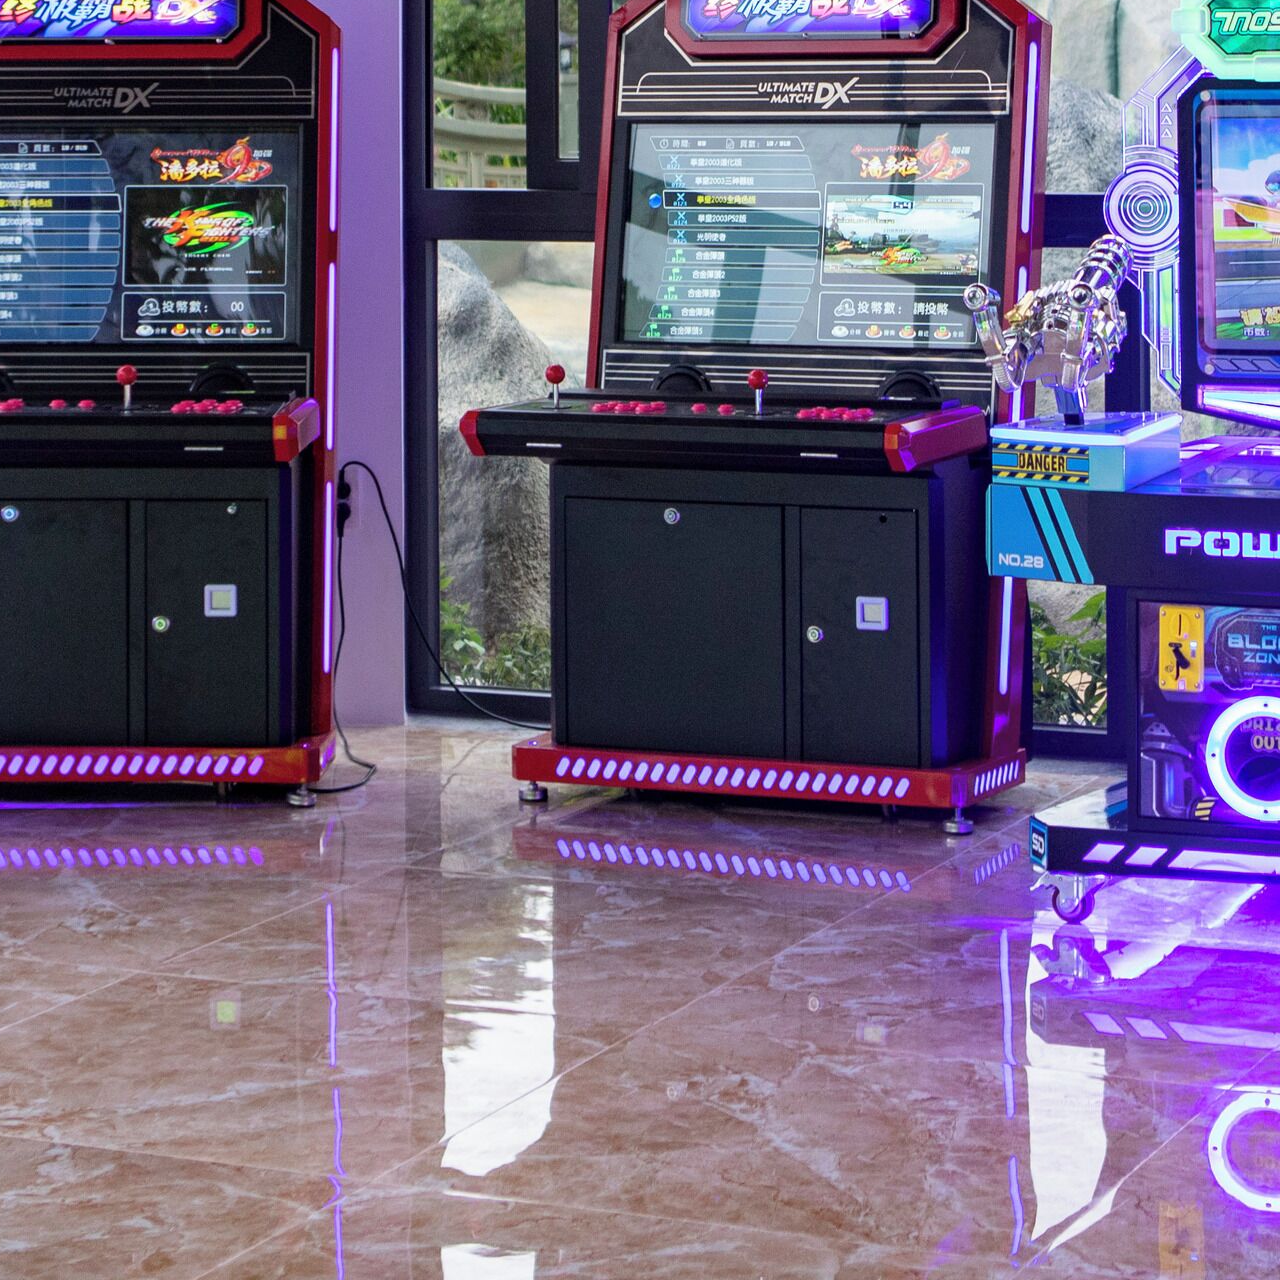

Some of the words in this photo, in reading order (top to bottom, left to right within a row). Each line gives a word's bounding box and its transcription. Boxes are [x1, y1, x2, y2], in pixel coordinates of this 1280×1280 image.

[54, 87, 114, 97] ULTIMATE
[758, 82, 815, 92] ULTIMATE
[814, 76, 860, 109] DX
[67, 98, 112, 108] MATCH
[113, 82, 160, 114] DX
[770, 93, 813, 103] MATCH
[231, 301, 244, 312] 00
[1018, 452, 1065, 472] DANGER
[999, 552, 1044, 569] NO.28
[1261, 624, 1277, 632] THE
[1031, 832, 1045, 854] SD
